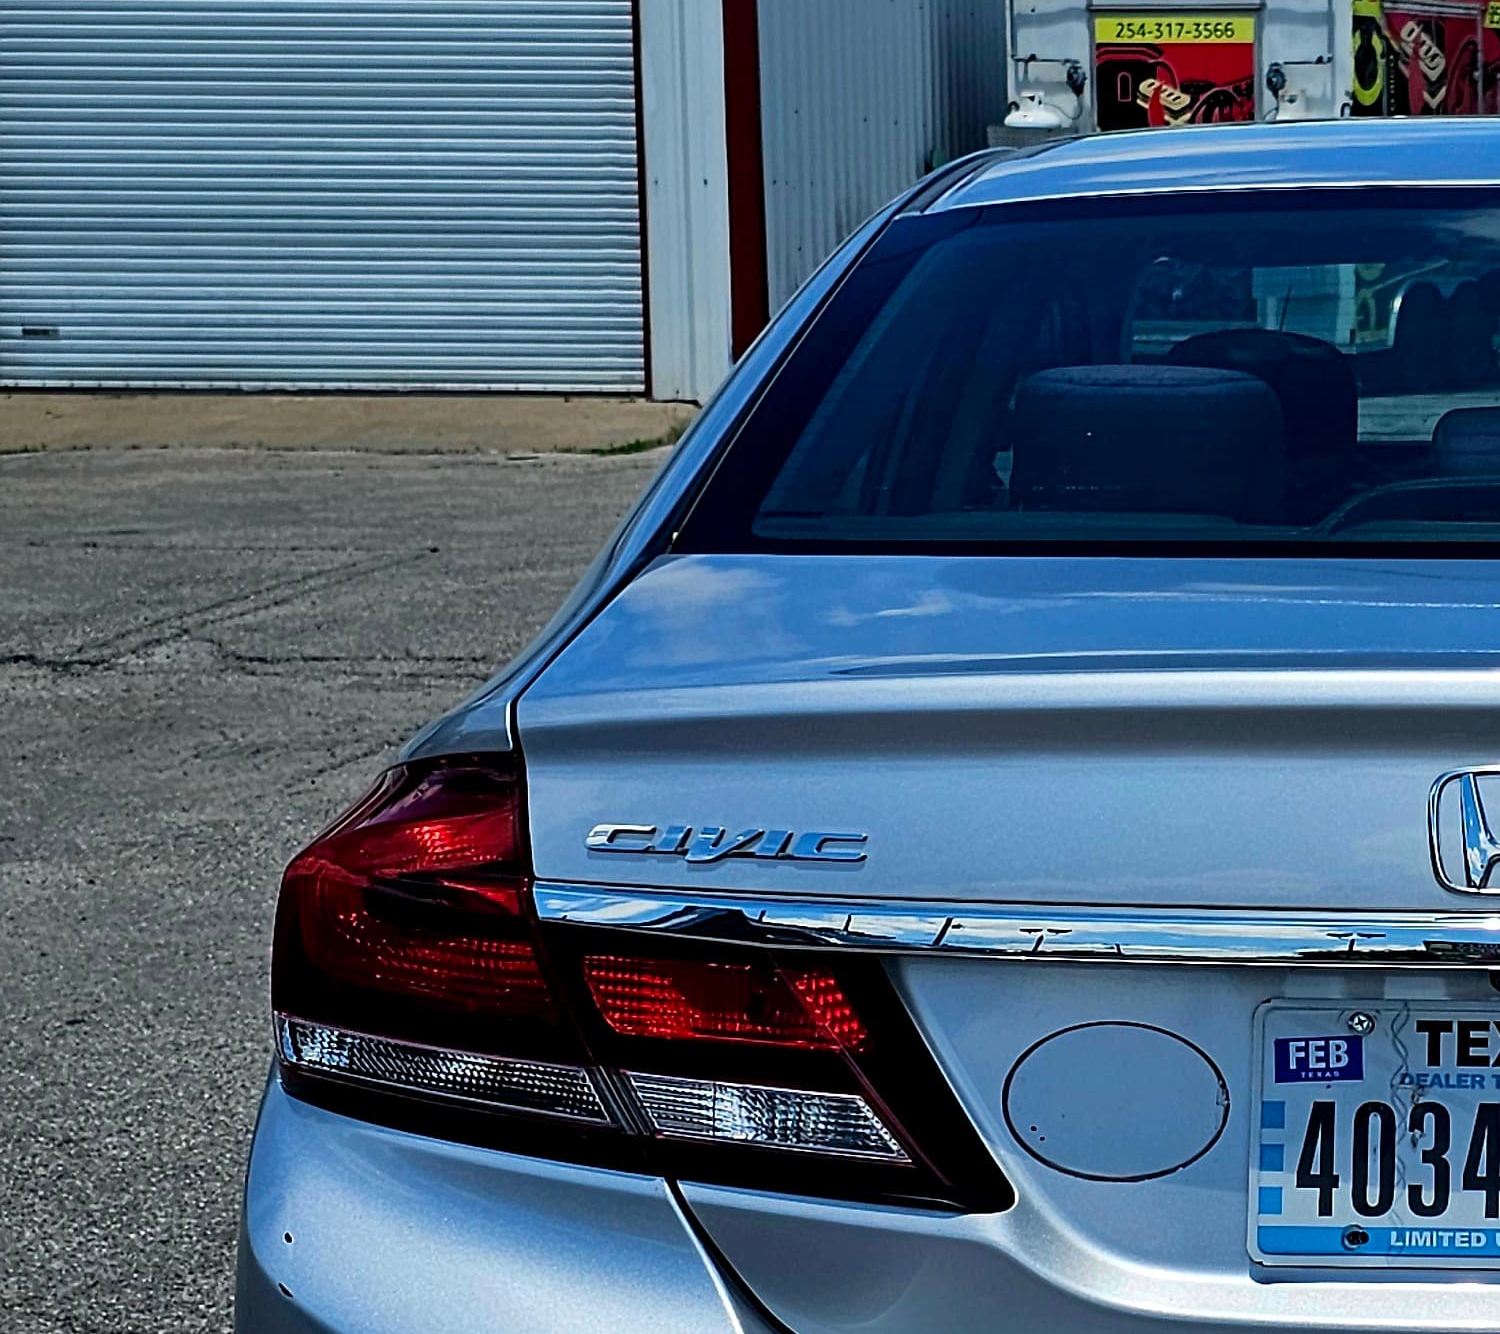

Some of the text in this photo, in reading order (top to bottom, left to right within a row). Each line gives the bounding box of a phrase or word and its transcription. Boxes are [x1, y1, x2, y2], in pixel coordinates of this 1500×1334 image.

[1115, 21, 1235, 39] 254-317-3566
[585, 823, 868, 863] CIVIC
[1289, 1040, 1349, 1069] FEB
[1301, 1071, 1340, 1079] TEXAS
[1400, 1072, 1485, 1090] DEALER
[1390, 1230, 1487, 1248] LIMITED
